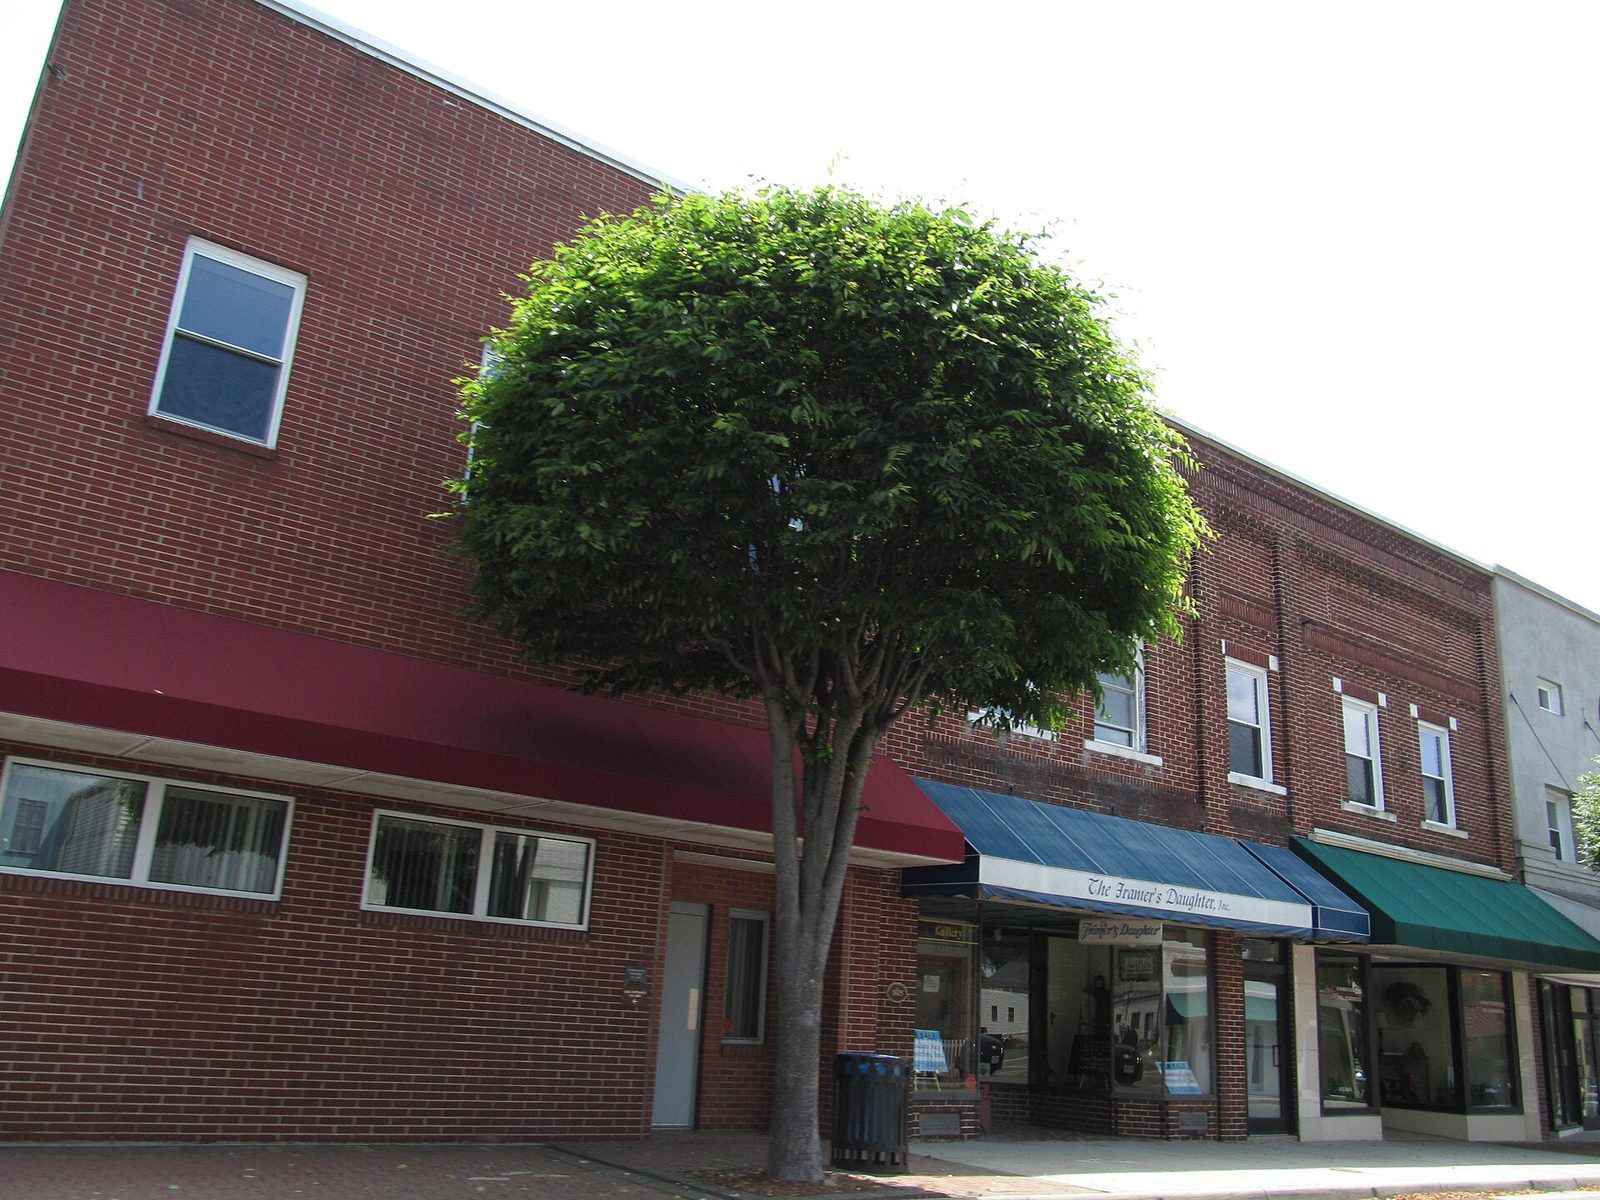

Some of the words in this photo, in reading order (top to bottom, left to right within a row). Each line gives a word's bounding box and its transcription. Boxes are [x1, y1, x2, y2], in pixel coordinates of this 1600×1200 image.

[1088, 877, 1111, 897] The
[1116, 882, 1162, 904] Framer's
[935, 925, 962, 941] Gallery
[1119, 923, 1161, 939] Daughter
